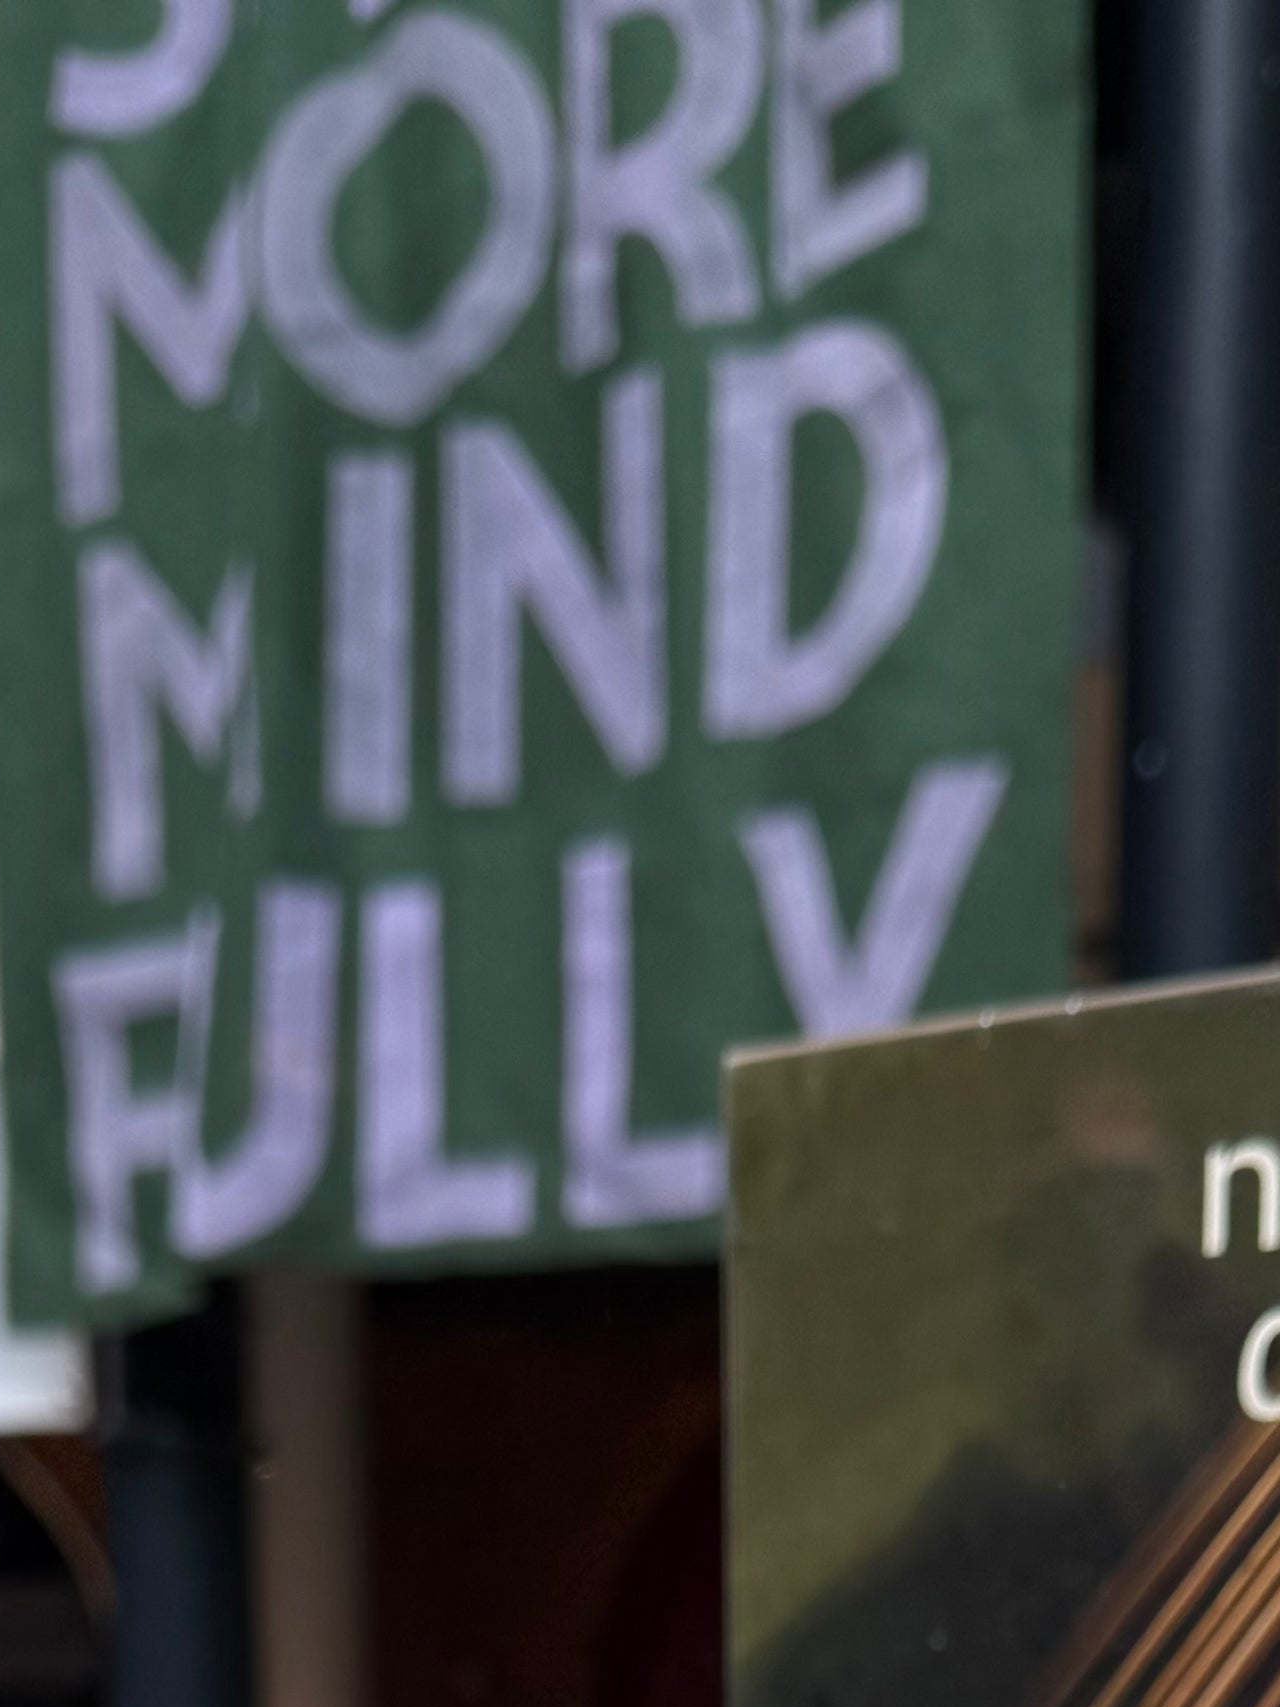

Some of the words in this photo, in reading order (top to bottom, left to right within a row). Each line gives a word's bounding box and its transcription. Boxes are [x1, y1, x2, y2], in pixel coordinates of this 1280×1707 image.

[48, 0, 930, 528] MORE
[78, 318, 949, 900] MIND
[55, 754, 1010, 1295] FULLY
